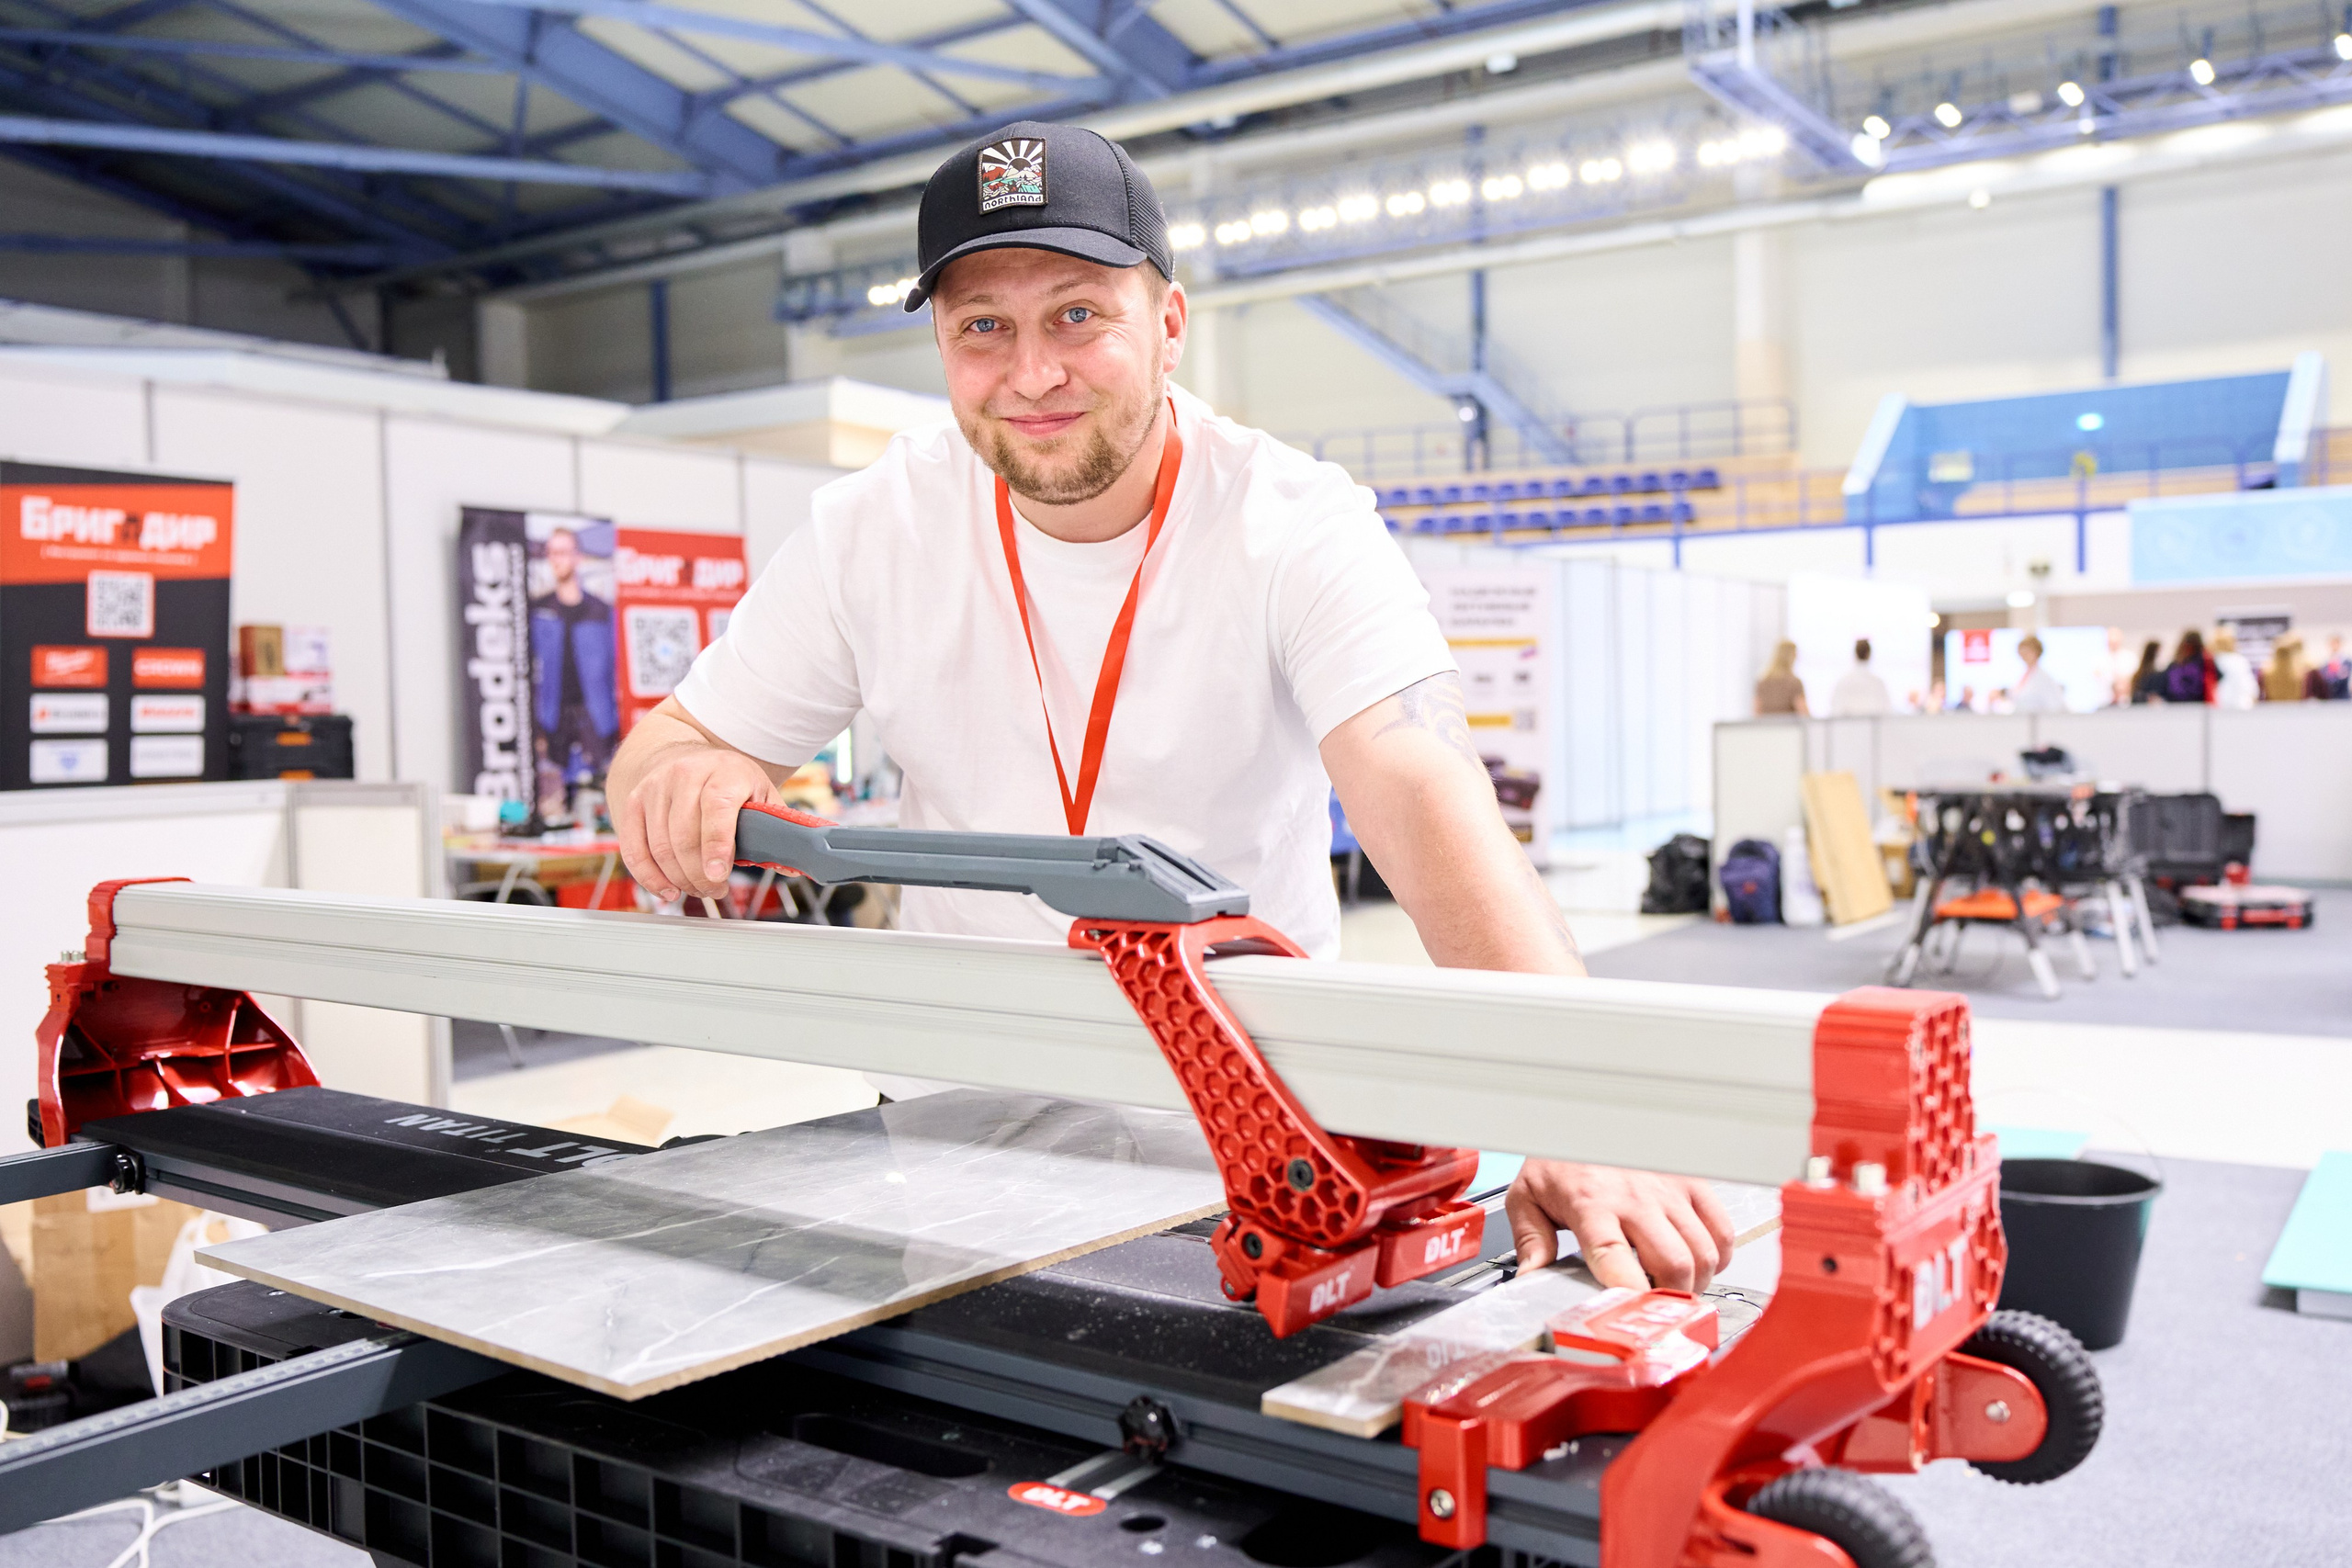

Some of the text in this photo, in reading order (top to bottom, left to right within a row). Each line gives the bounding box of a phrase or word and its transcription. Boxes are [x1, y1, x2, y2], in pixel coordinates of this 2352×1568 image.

[384, 1113, 528, 1144] TITAN
[1424, 1227, 1466, 1264] DLT
[1308, 1270, 1351, 1314] DLT
[1913, 1232, 1966, 1332] DLT
[1021, 1486, 1091, 1511] DLT
